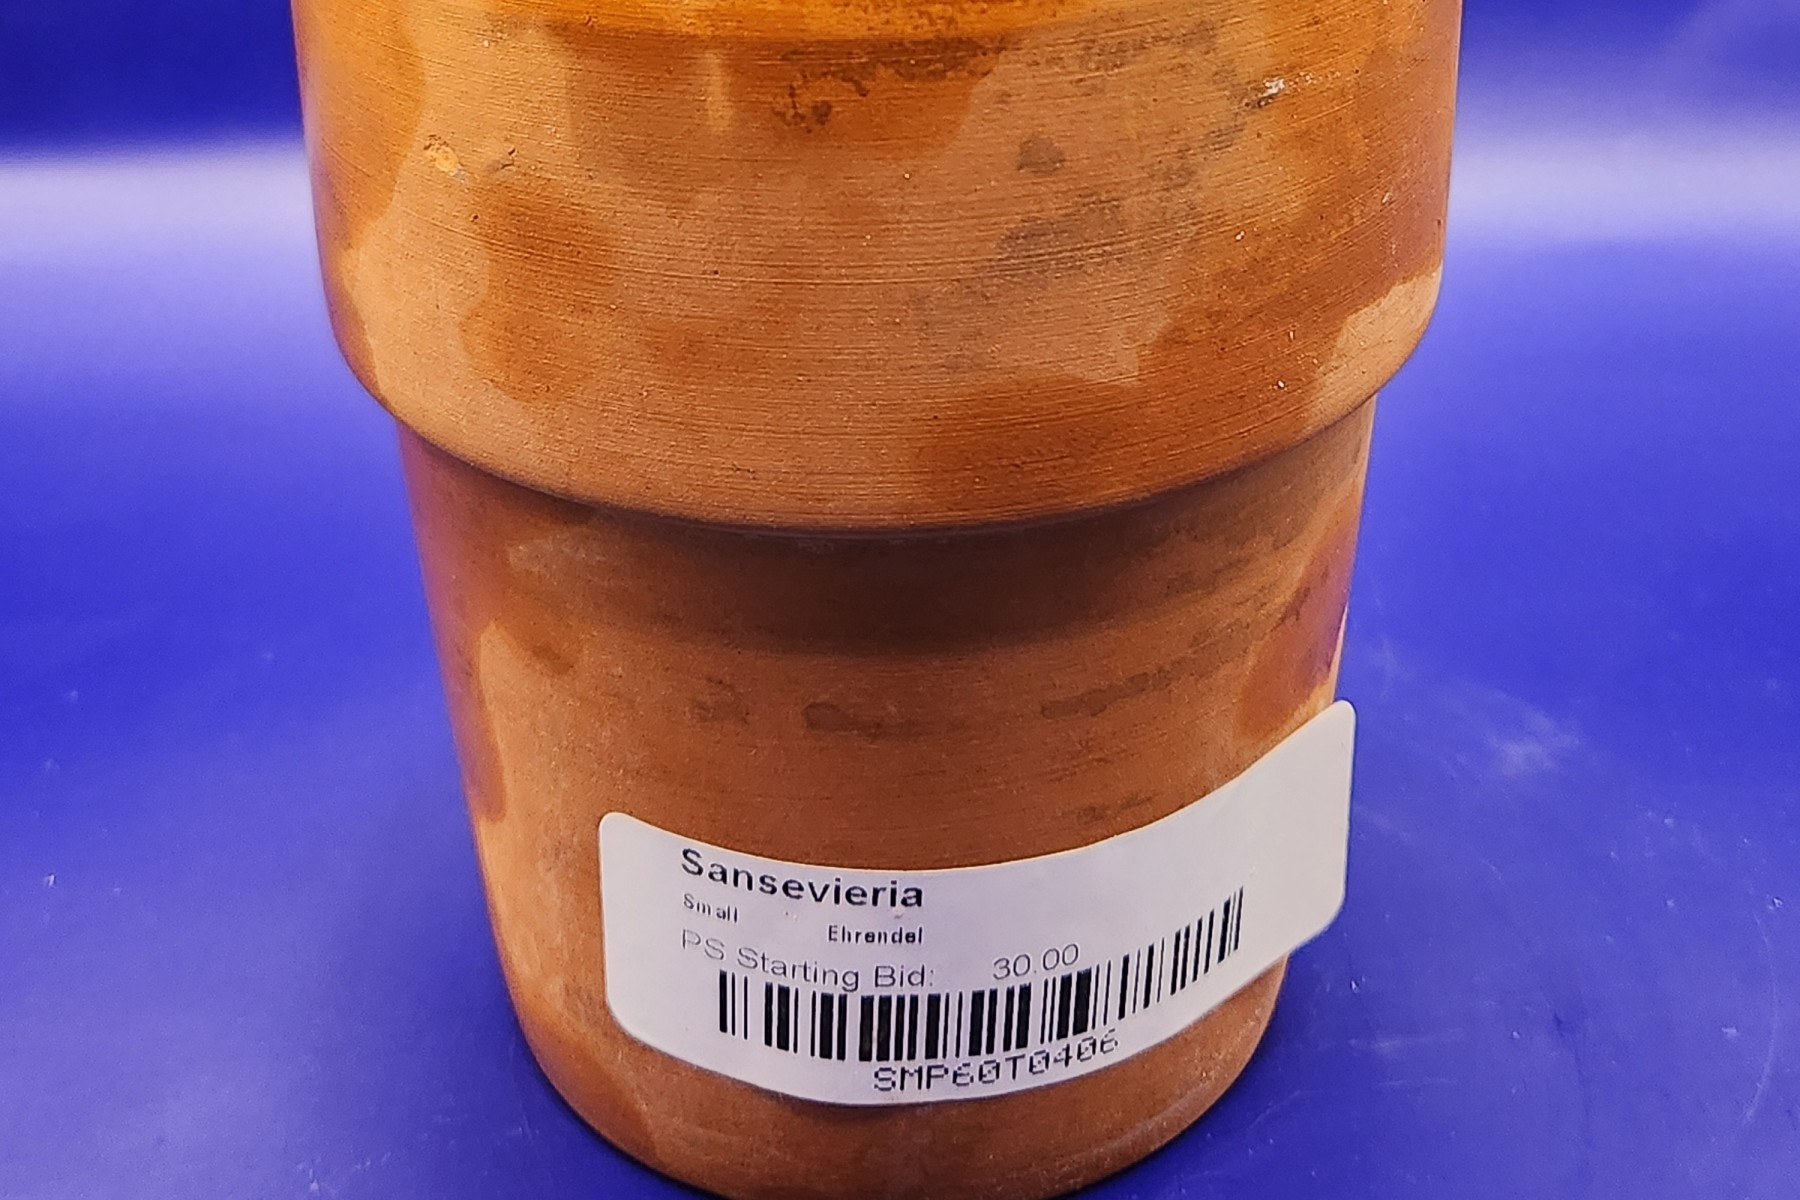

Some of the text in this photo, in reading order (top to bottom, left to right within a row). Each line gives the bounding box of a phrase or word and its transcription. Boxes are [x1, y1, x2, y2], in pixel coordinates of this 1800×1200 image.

[681, 848, 923, 907] Sansevieria
[683, 893, 738, 923] Small
[682, 928, 1079, 993] PS Starting Bid: 30.00
[874, 1028, 1118, 1091] SMP60T0406
